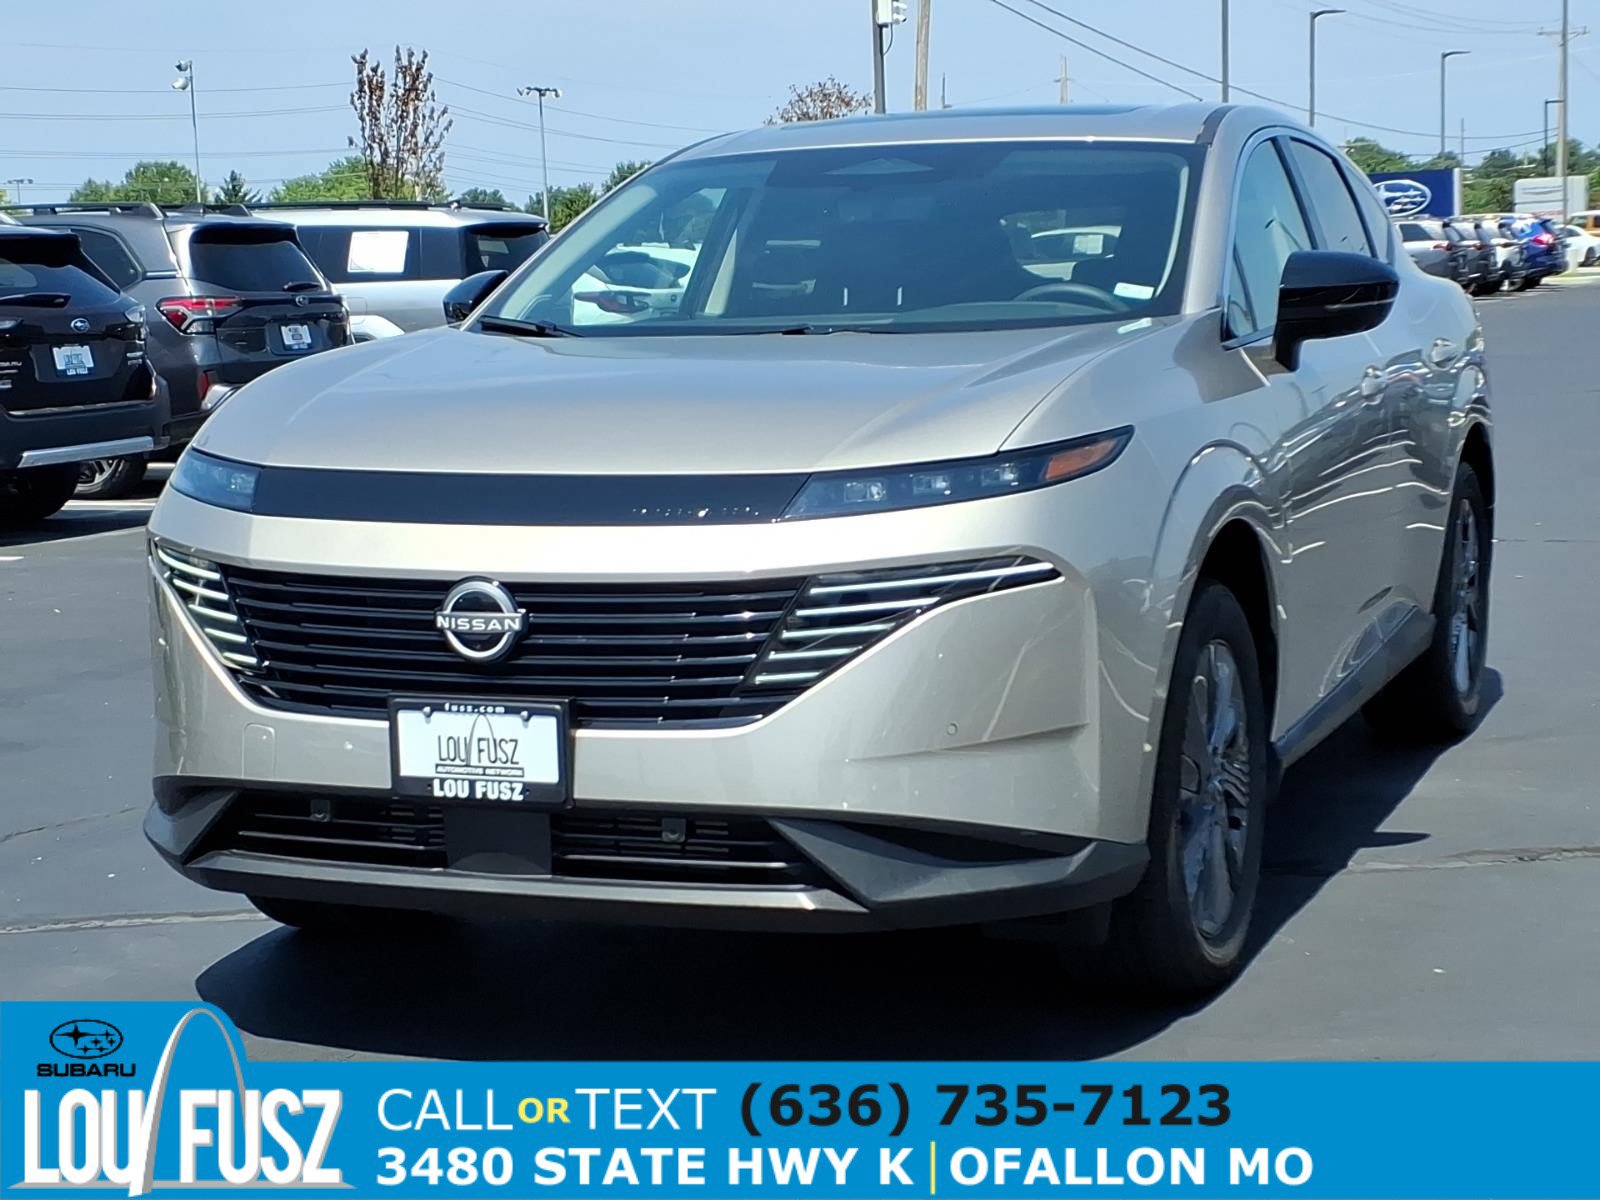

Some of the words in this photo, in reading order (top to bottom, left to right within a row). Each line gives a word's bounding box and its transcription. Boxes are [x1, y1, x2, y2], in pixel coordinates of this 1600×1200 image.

[436, 614, 520, 631] NISSAN
[444, 702, 505, 714] fusz.com
[437, 735, 468, 763] LOU
[477, 738, 520, 765] FUSZ
[433, 779, 470, 798] LOU
[475, 781, 524, 802] FUSZ
